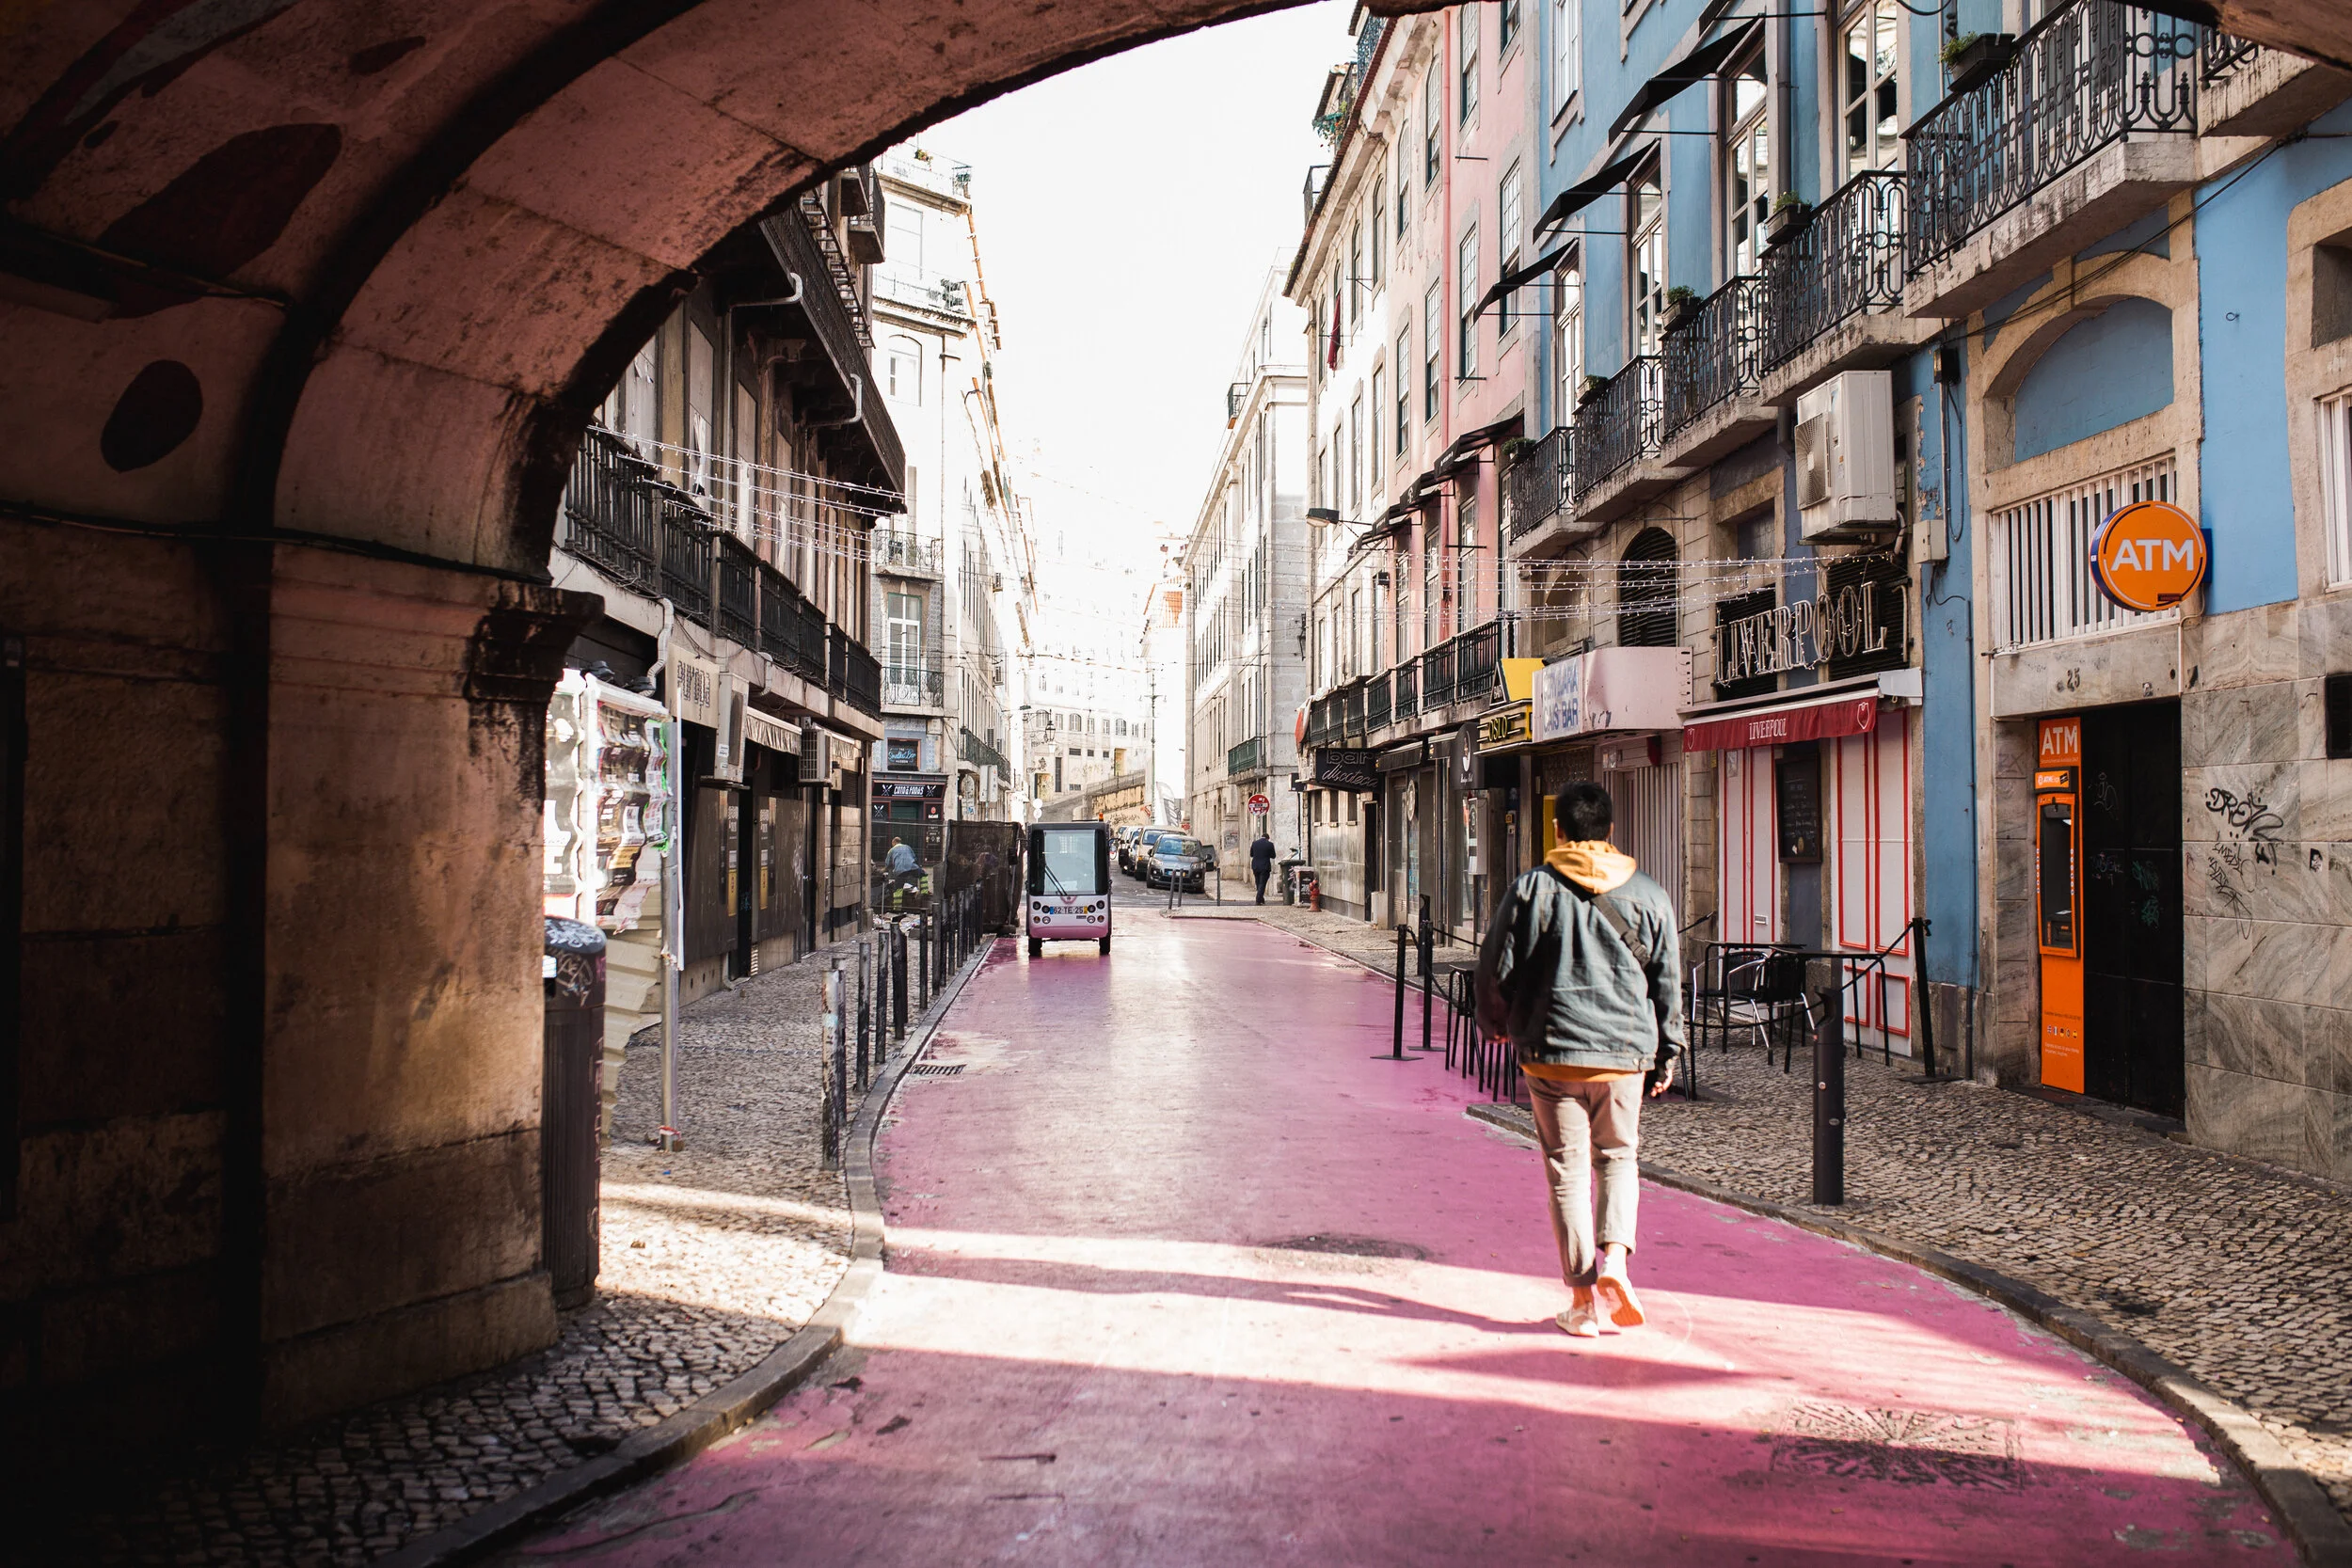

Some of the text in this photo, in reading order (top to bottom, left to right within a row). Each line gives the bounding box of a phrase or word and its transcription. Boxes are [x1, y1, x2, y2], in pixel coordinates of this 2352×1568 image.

[2110, 539, 2195, 571] ATM
[1715, 581, 1888, 686] LIVERPOOL
[2066, 667, 2081, 692] 25
[1562, 698, 1579, 729] BAR
[1488, 716, 1508, 742] OSLO
[1749, 718, 1788, 741] LIVERPOOL
[2041, 725, 2079, 755] ATM
[1327, 750, 1375, 765] bar
[1322, 764, 1379, 788] discoteca
